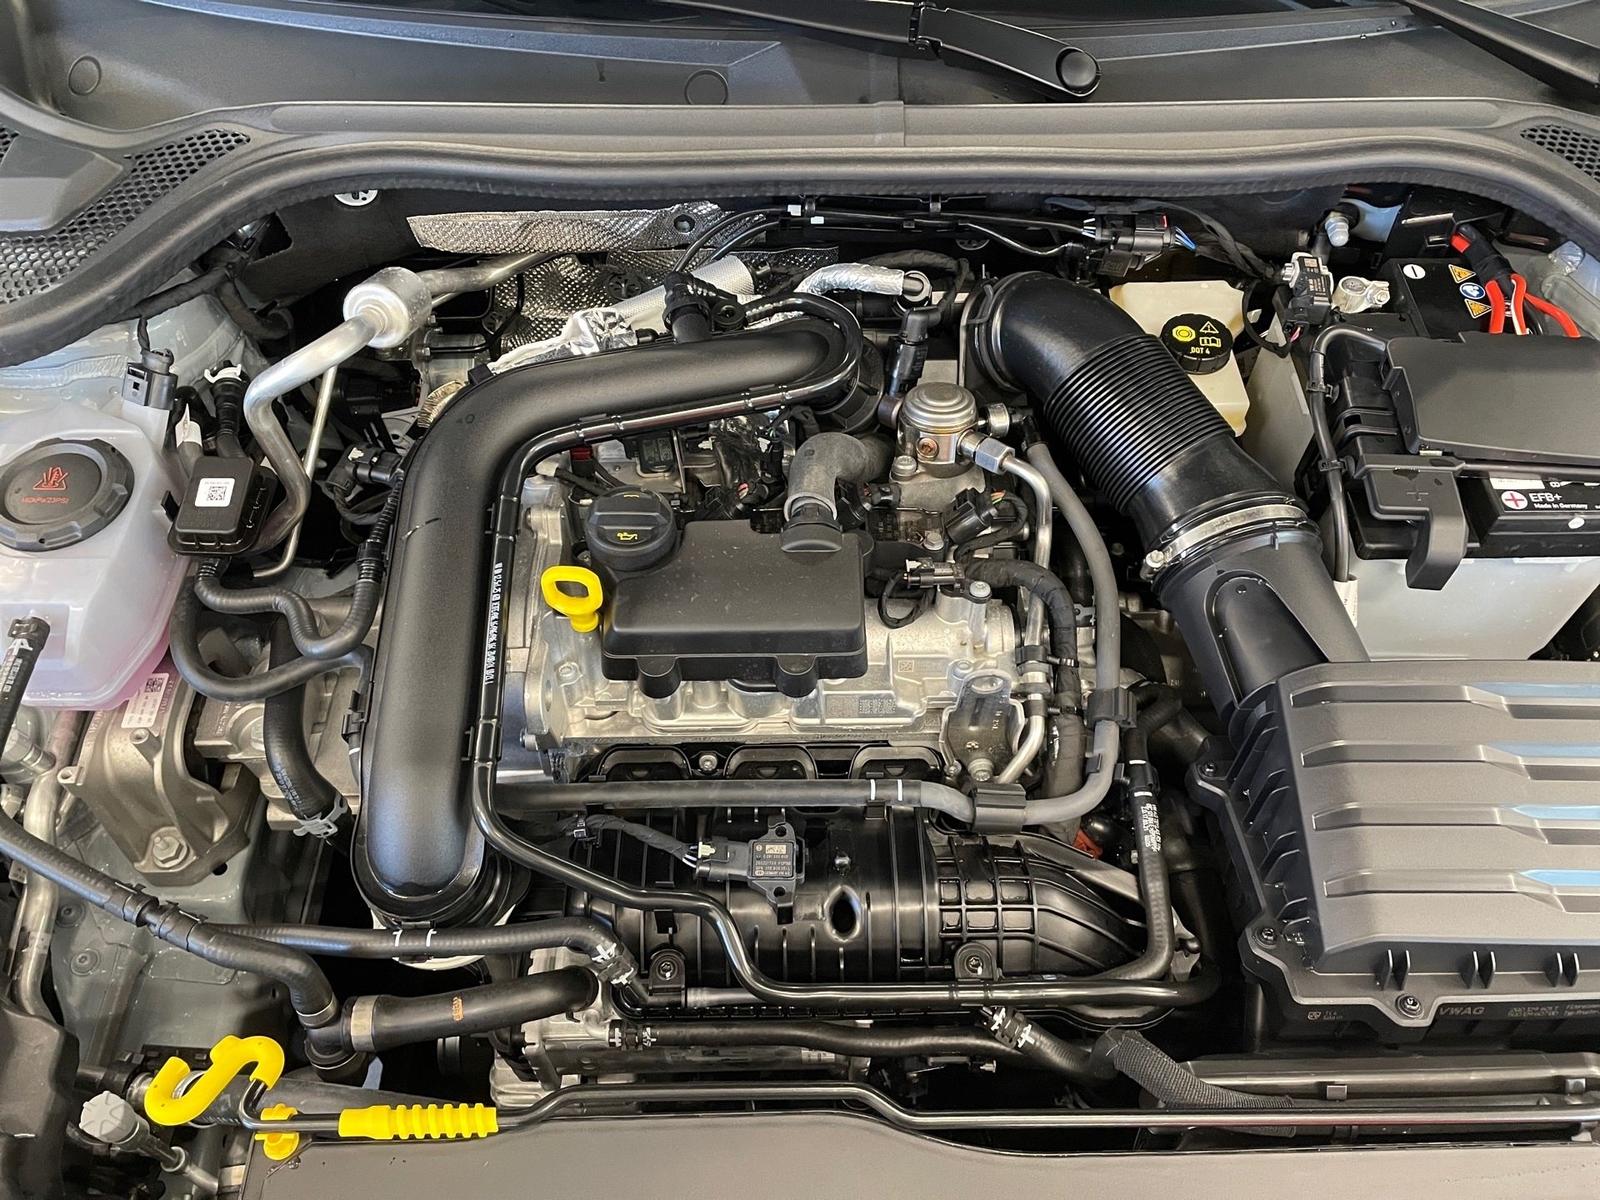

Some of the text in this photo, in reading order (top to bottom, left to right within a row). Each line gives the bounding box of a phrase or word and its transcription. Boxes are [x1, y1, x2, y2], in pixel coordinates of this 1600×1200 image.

[1190, 346, 1204, 354] DOT
[1529, 493, 1562, 502] EFB+
[1440, 1006, 1486, 1016] VWAG
